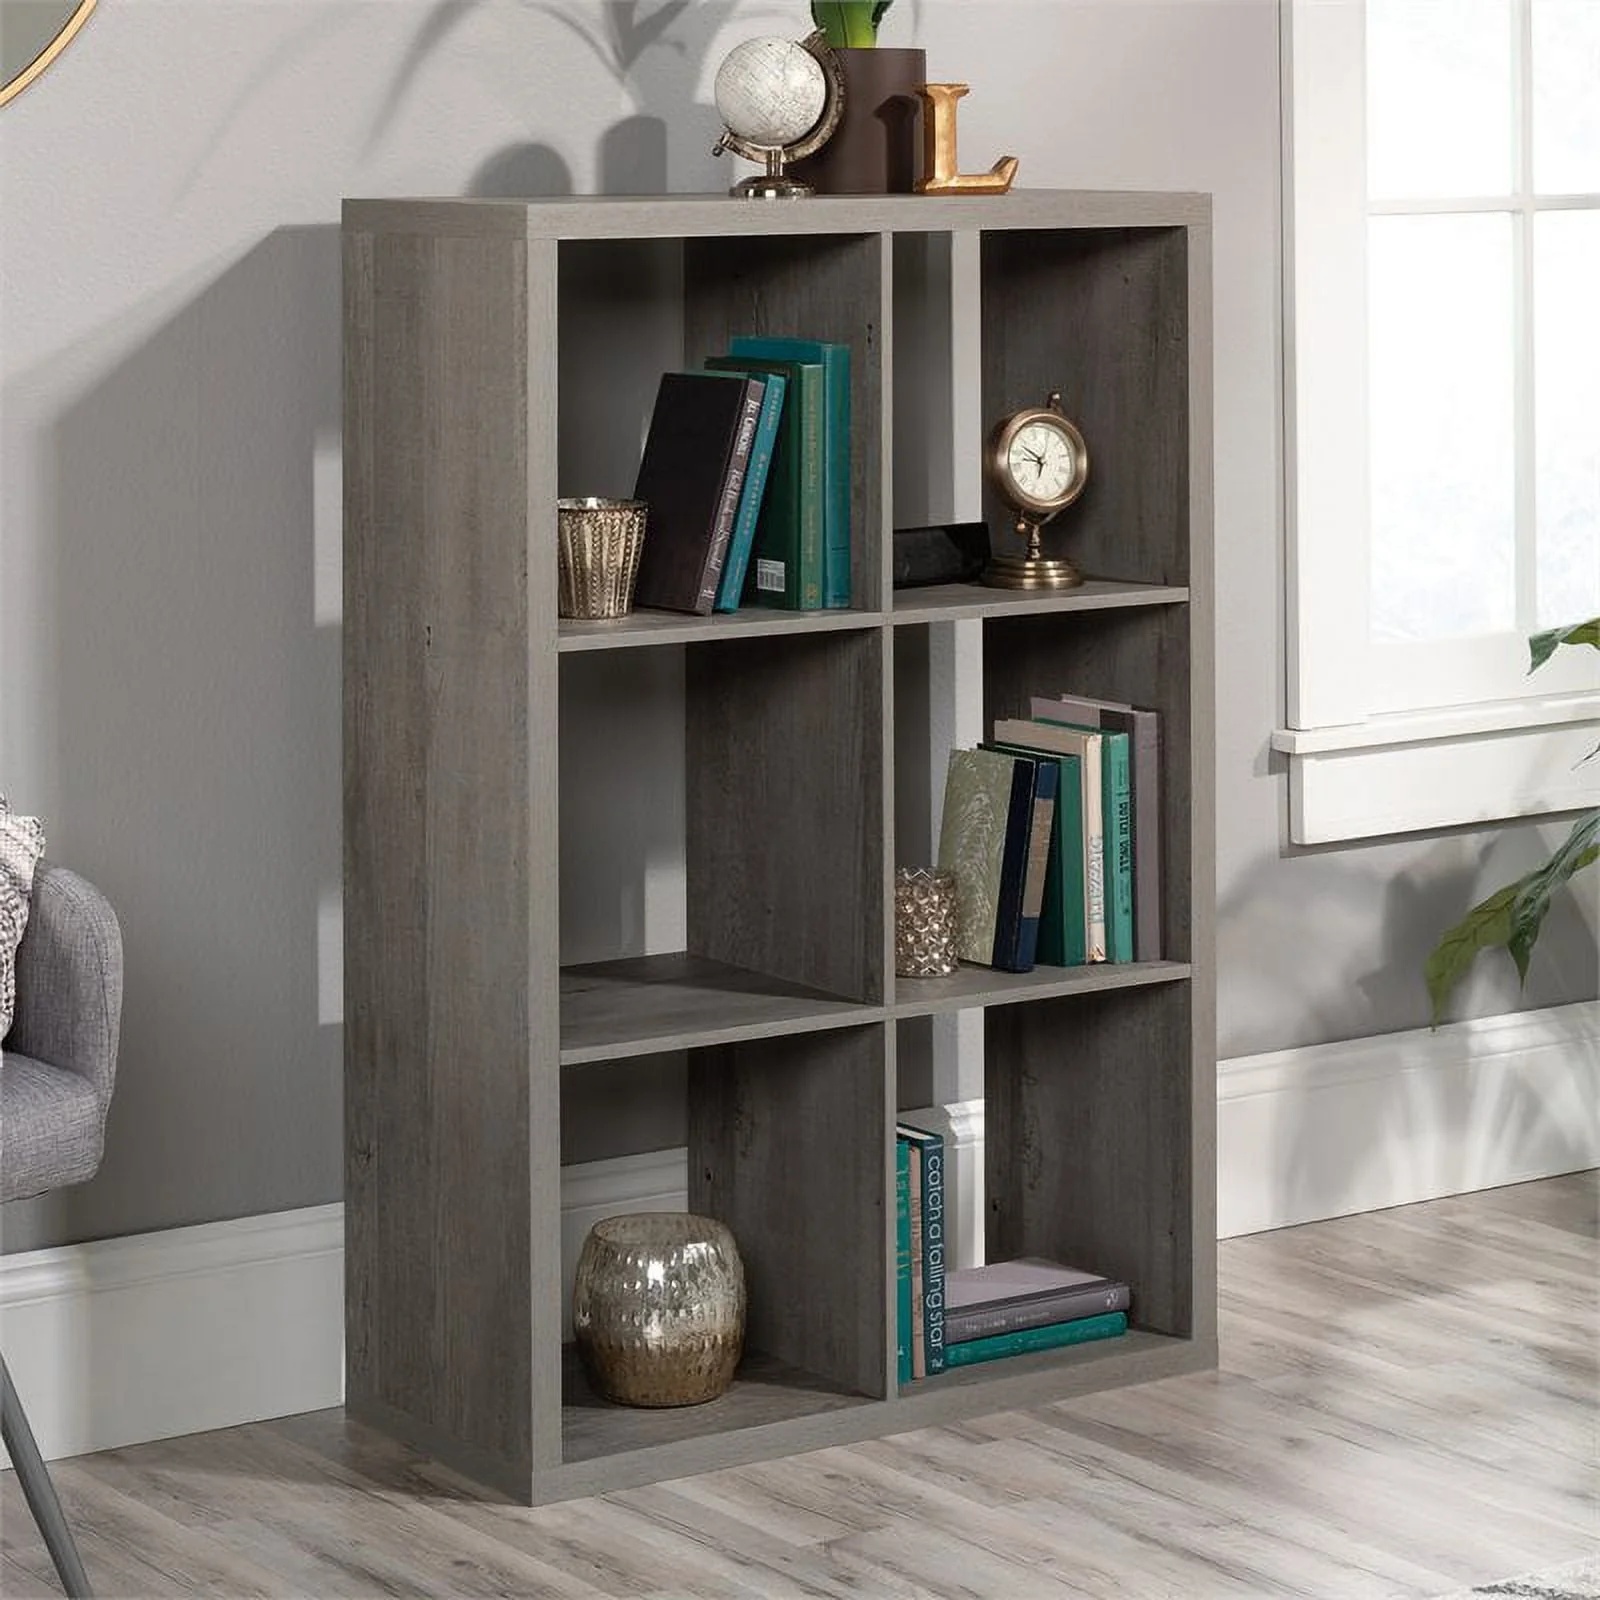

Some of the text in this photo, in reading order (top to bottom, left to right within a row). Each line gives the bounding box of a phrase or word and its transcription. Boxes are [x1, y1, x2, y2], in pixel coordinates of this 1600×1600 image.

[913, 83, 1020, 194] L
[928, 1155, 943, 1220] catch
[930, 1224, 941, 1240] a
[926, 1243, 944, 1309] falling
[930, 1310, 943, 1349] star
